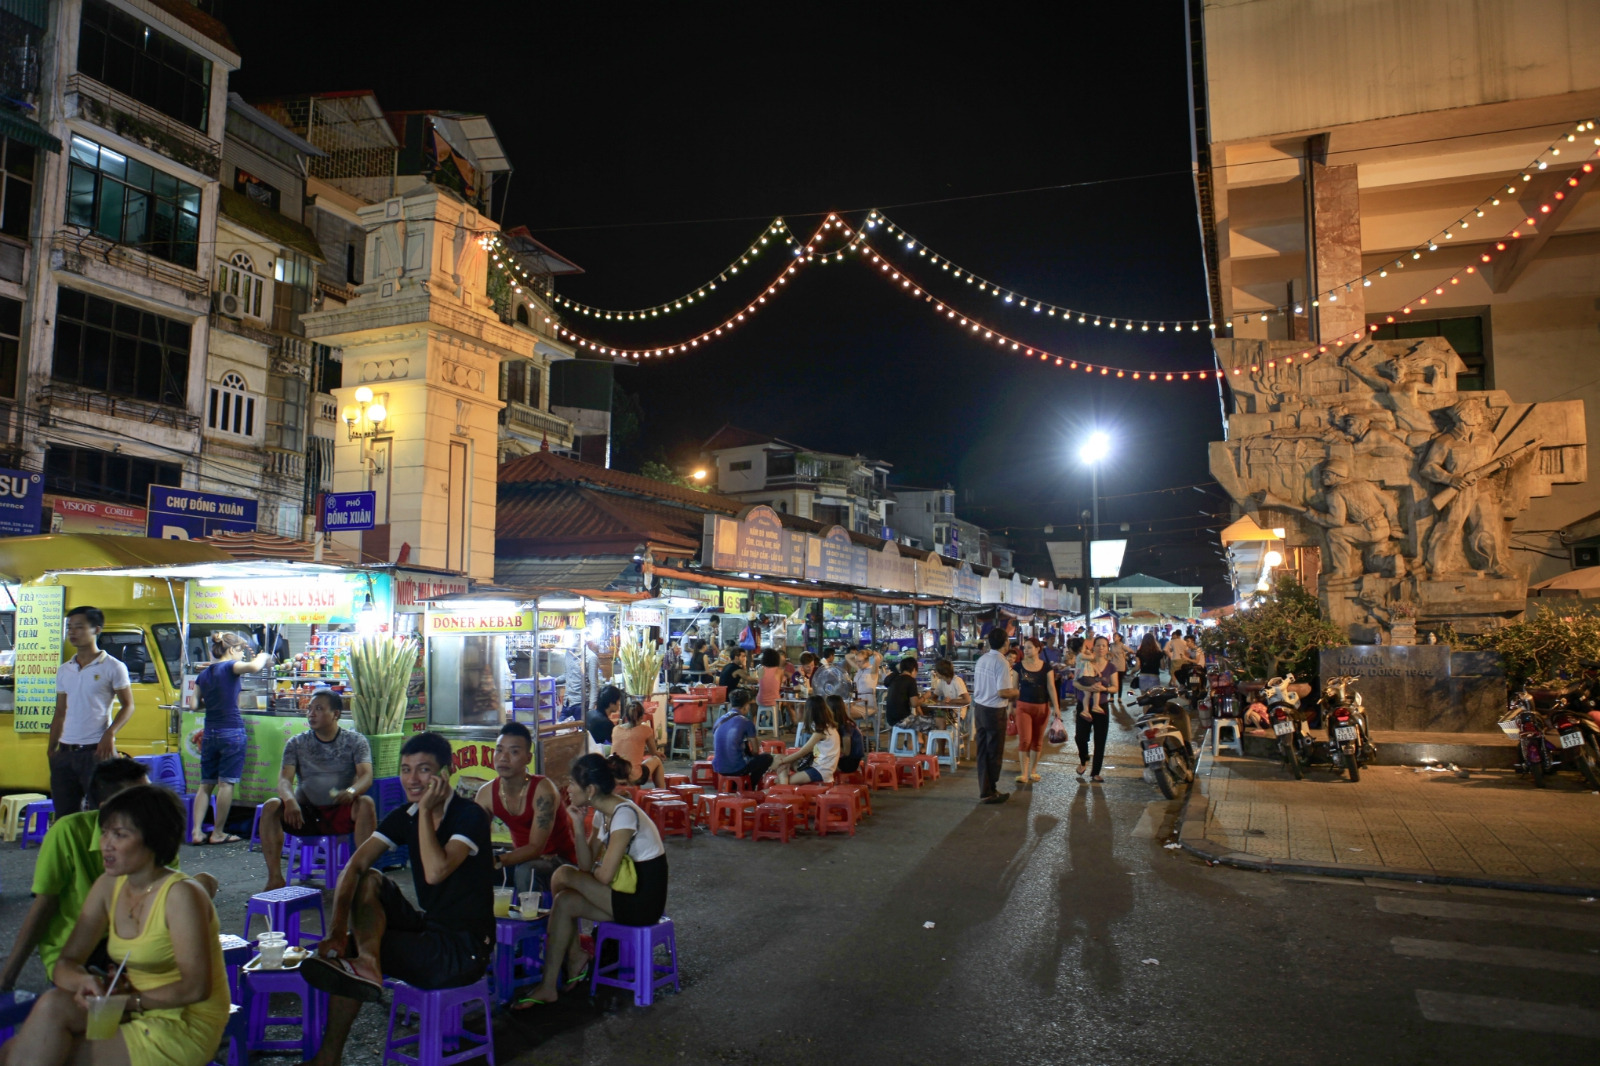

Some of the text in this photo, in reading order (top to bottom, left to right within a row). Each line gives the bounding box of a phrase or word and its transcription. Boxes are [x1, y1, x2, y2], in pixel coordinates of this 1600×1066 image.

[166, 496, 188, 511] CHỢ
[218, 502, 245, 516] XUÂN
[345, 496, 361, 508] PHỐ
[104, 505, 135, 517] CORELLE
[349, 508, 372, 525] XUÂN
[433, 615, 523, 629] DONER KEBAB
[17, 664, 41, 675] 12.000
